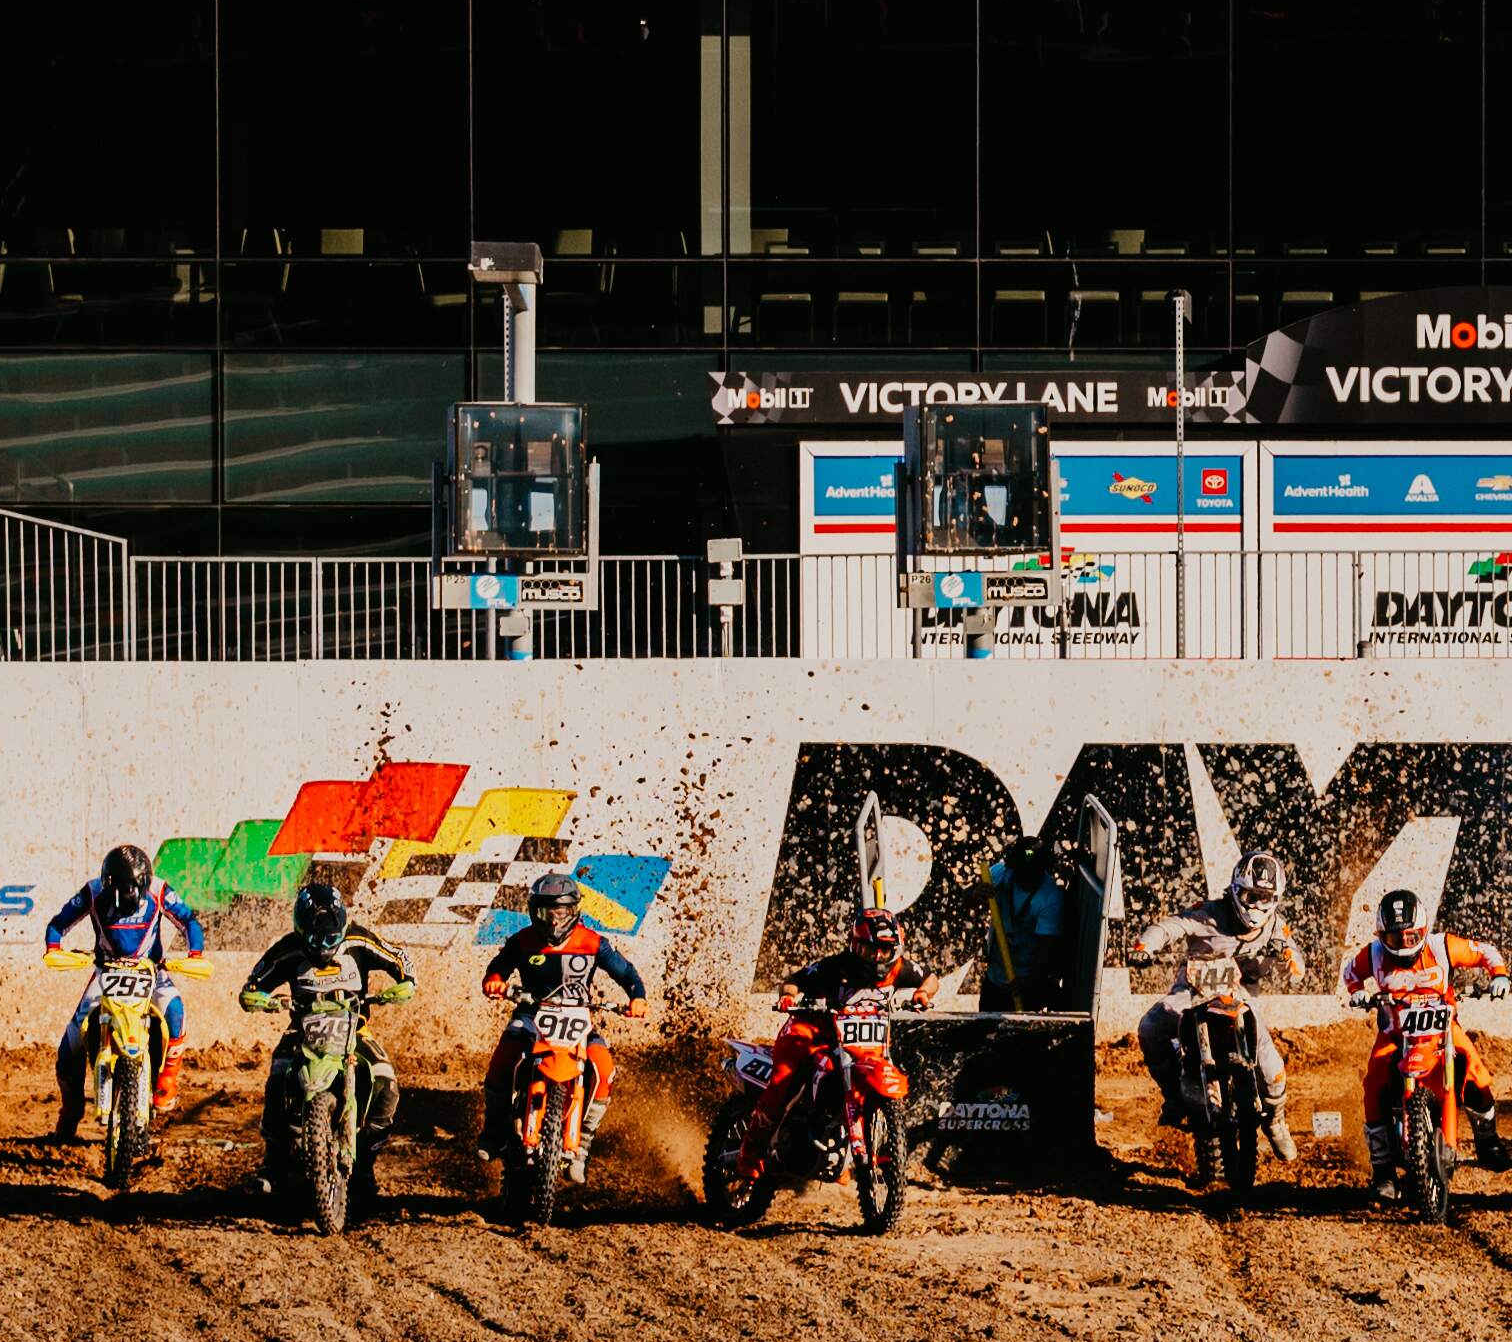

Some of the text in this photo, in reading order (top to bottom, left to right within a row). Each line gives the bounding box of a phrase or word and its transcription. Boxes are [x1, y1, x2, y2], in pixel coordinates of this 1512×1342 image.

[728, 387, 806, 409] Mobil 1
[840, 382, 1118, 413] VICTORY LANE
[826, 485, 895, 498] AdventHea
[1112, 484, 1155, 493] SUNOCO
[1284, 484, 1369, 498] AdventHealth
[1196, 499, 1233, 507] TOYOTA
[988, 585, 1046, 599] musco
[911, 632, 1140, 645] INTERIONAL SPEEDWAY
[1368, 631, 1502, 644] INTERNATIONAL
[103, 976, 152, 999] 293
[538, 1014, 588, 1041] 918
[1402, 1009, 1451, 1034] 408
[844, 1023, 886, 1043] 800
[937, 1103, 1030, 1119] DAYTONA
[937, 1119, 1031, 1132] SUPERCROSS
